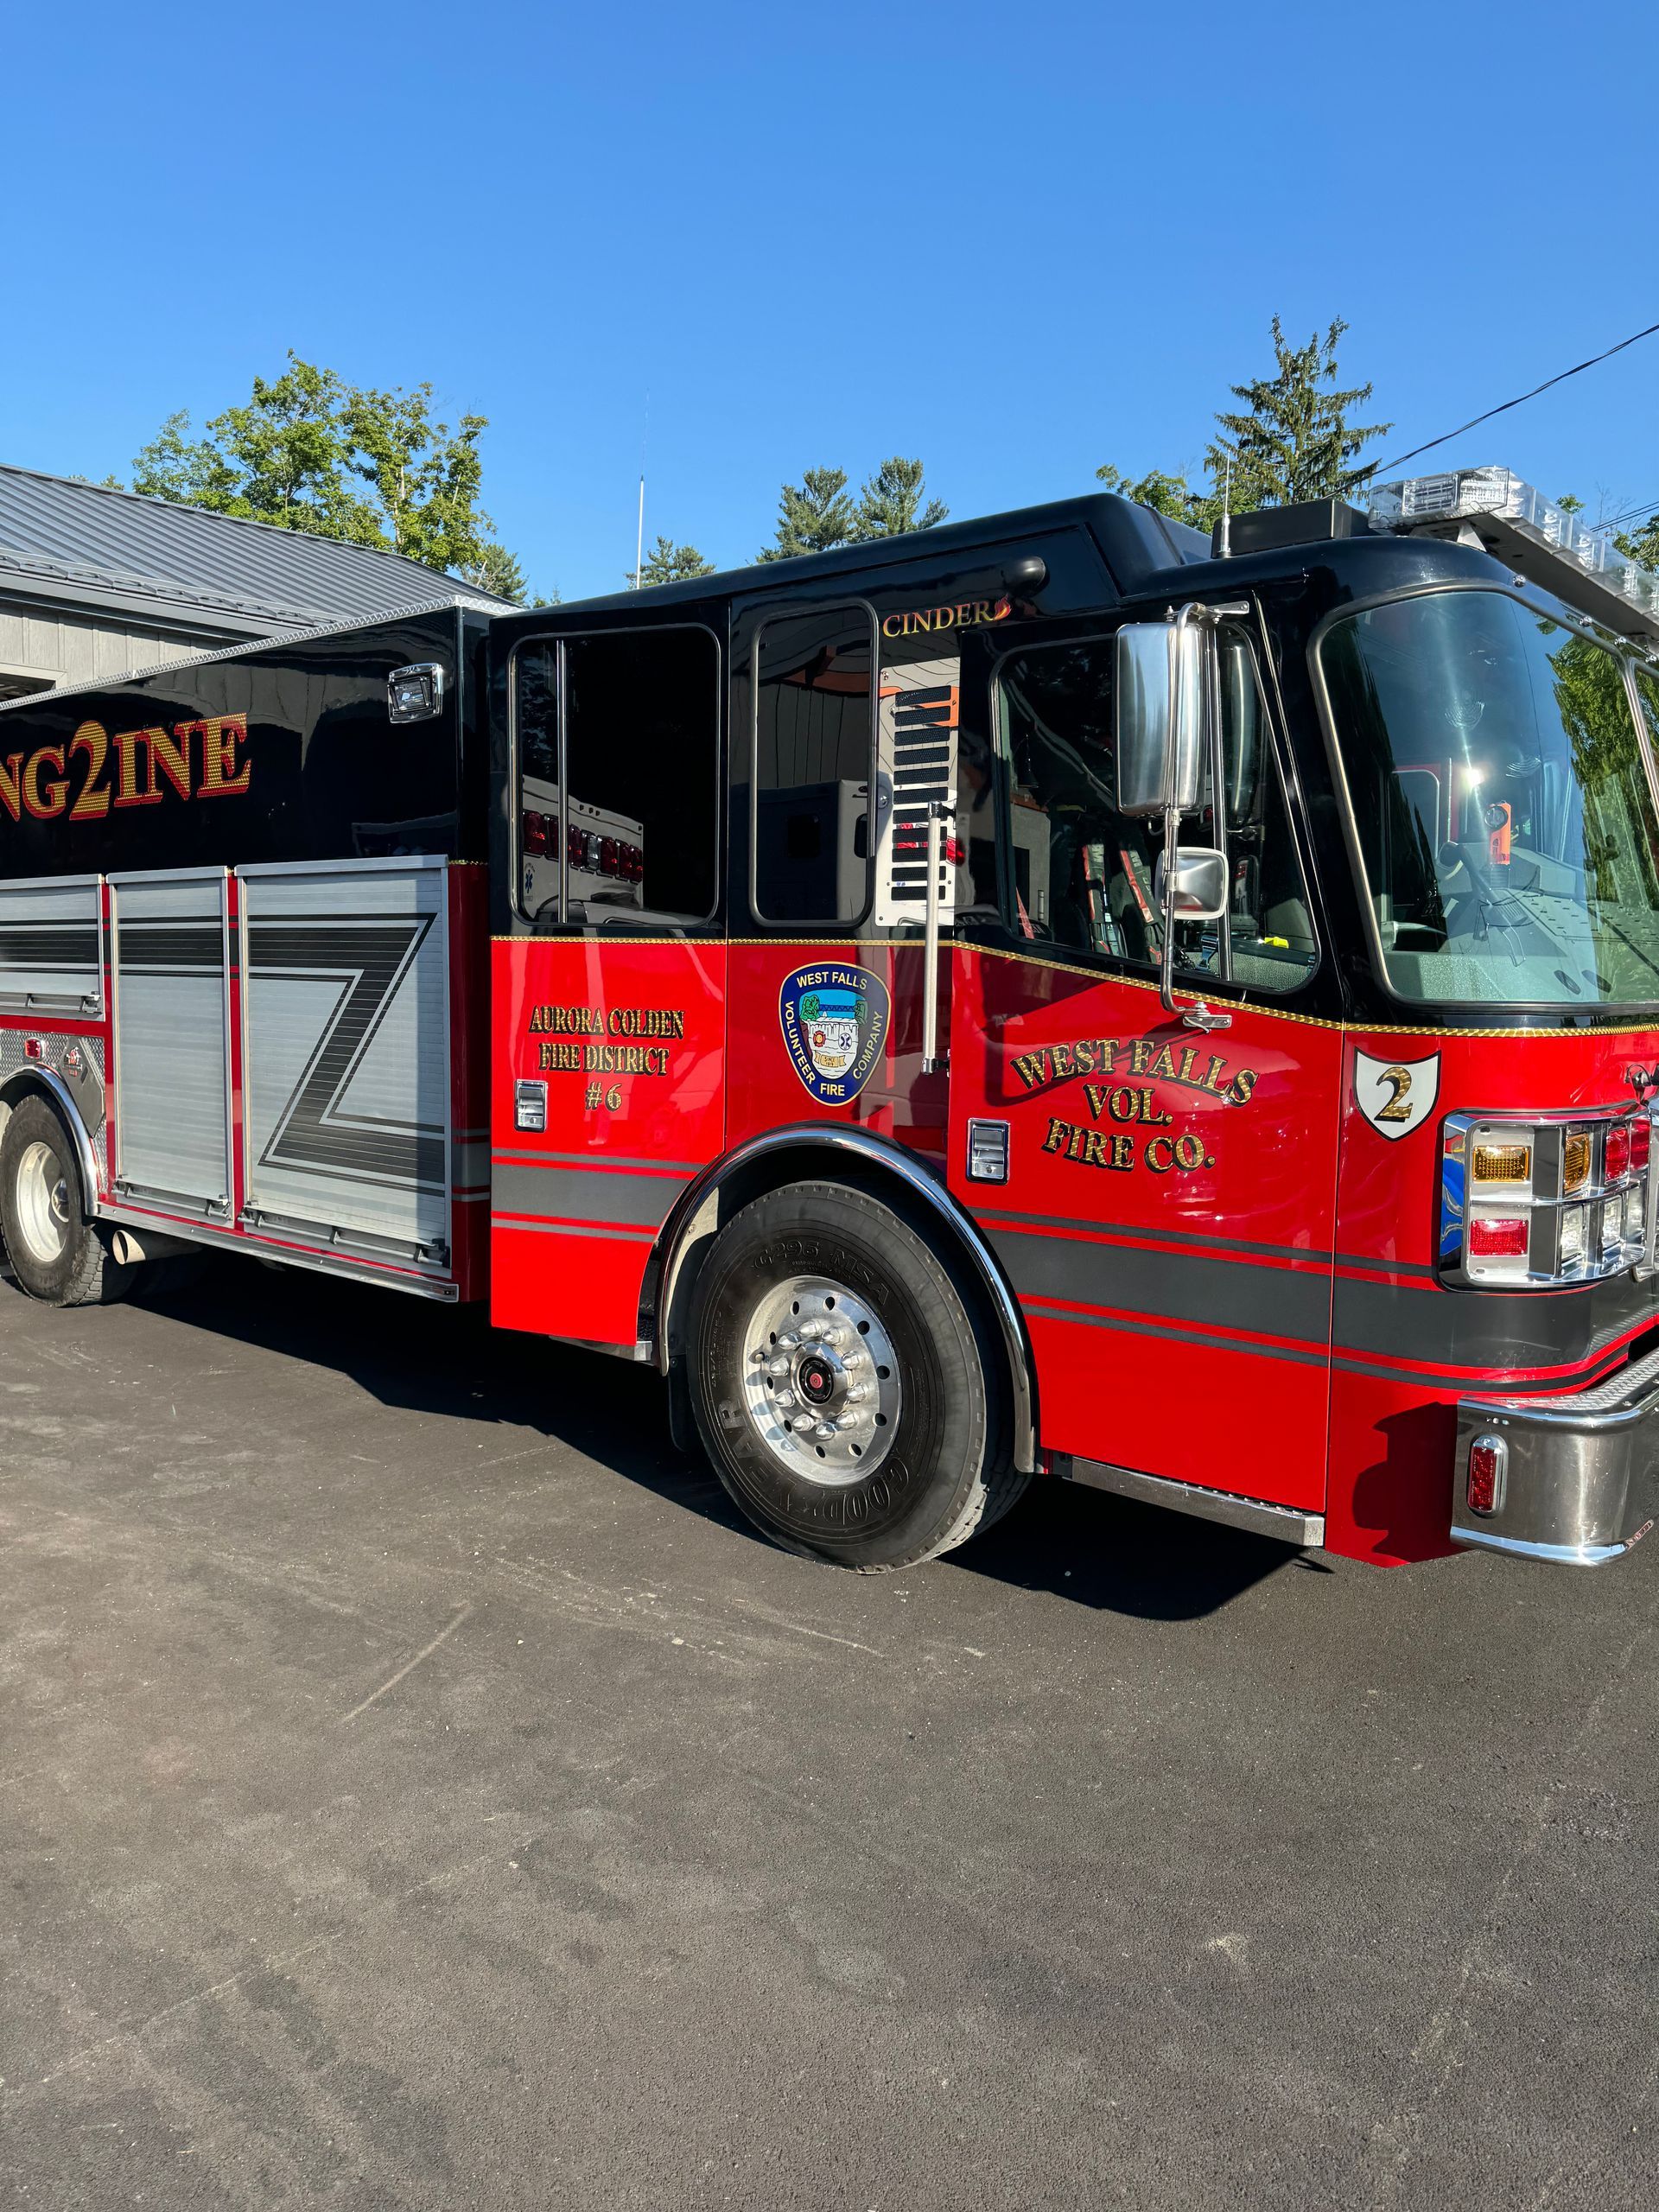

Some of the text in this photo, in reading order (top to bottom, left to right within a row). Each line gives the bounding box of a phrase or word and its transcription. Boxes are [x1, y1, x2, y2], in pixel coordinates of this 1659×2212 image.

[882, 600, 994, 638] CINDER
[797, 971, 868, 990] WEST FALLS
[529, 1006, 684, 1039] AURORA COLDEN
[785, 1001, 817, 1084] VOLUNTEER
[538, 1042, 670, 1077] FIRE DISTRICT
[853, 1011, 883, 1079] COMPANY
[820, 1083, 845, 1097] FIRE
[1010, 1038, 1260, 1107] WEST FALLS
[1083, 1084, 1174, 1126] VOL.
[1374, 1065, 1414, 1123] 2
[1041, 1117, 1217, 1173] FIRE CO.
